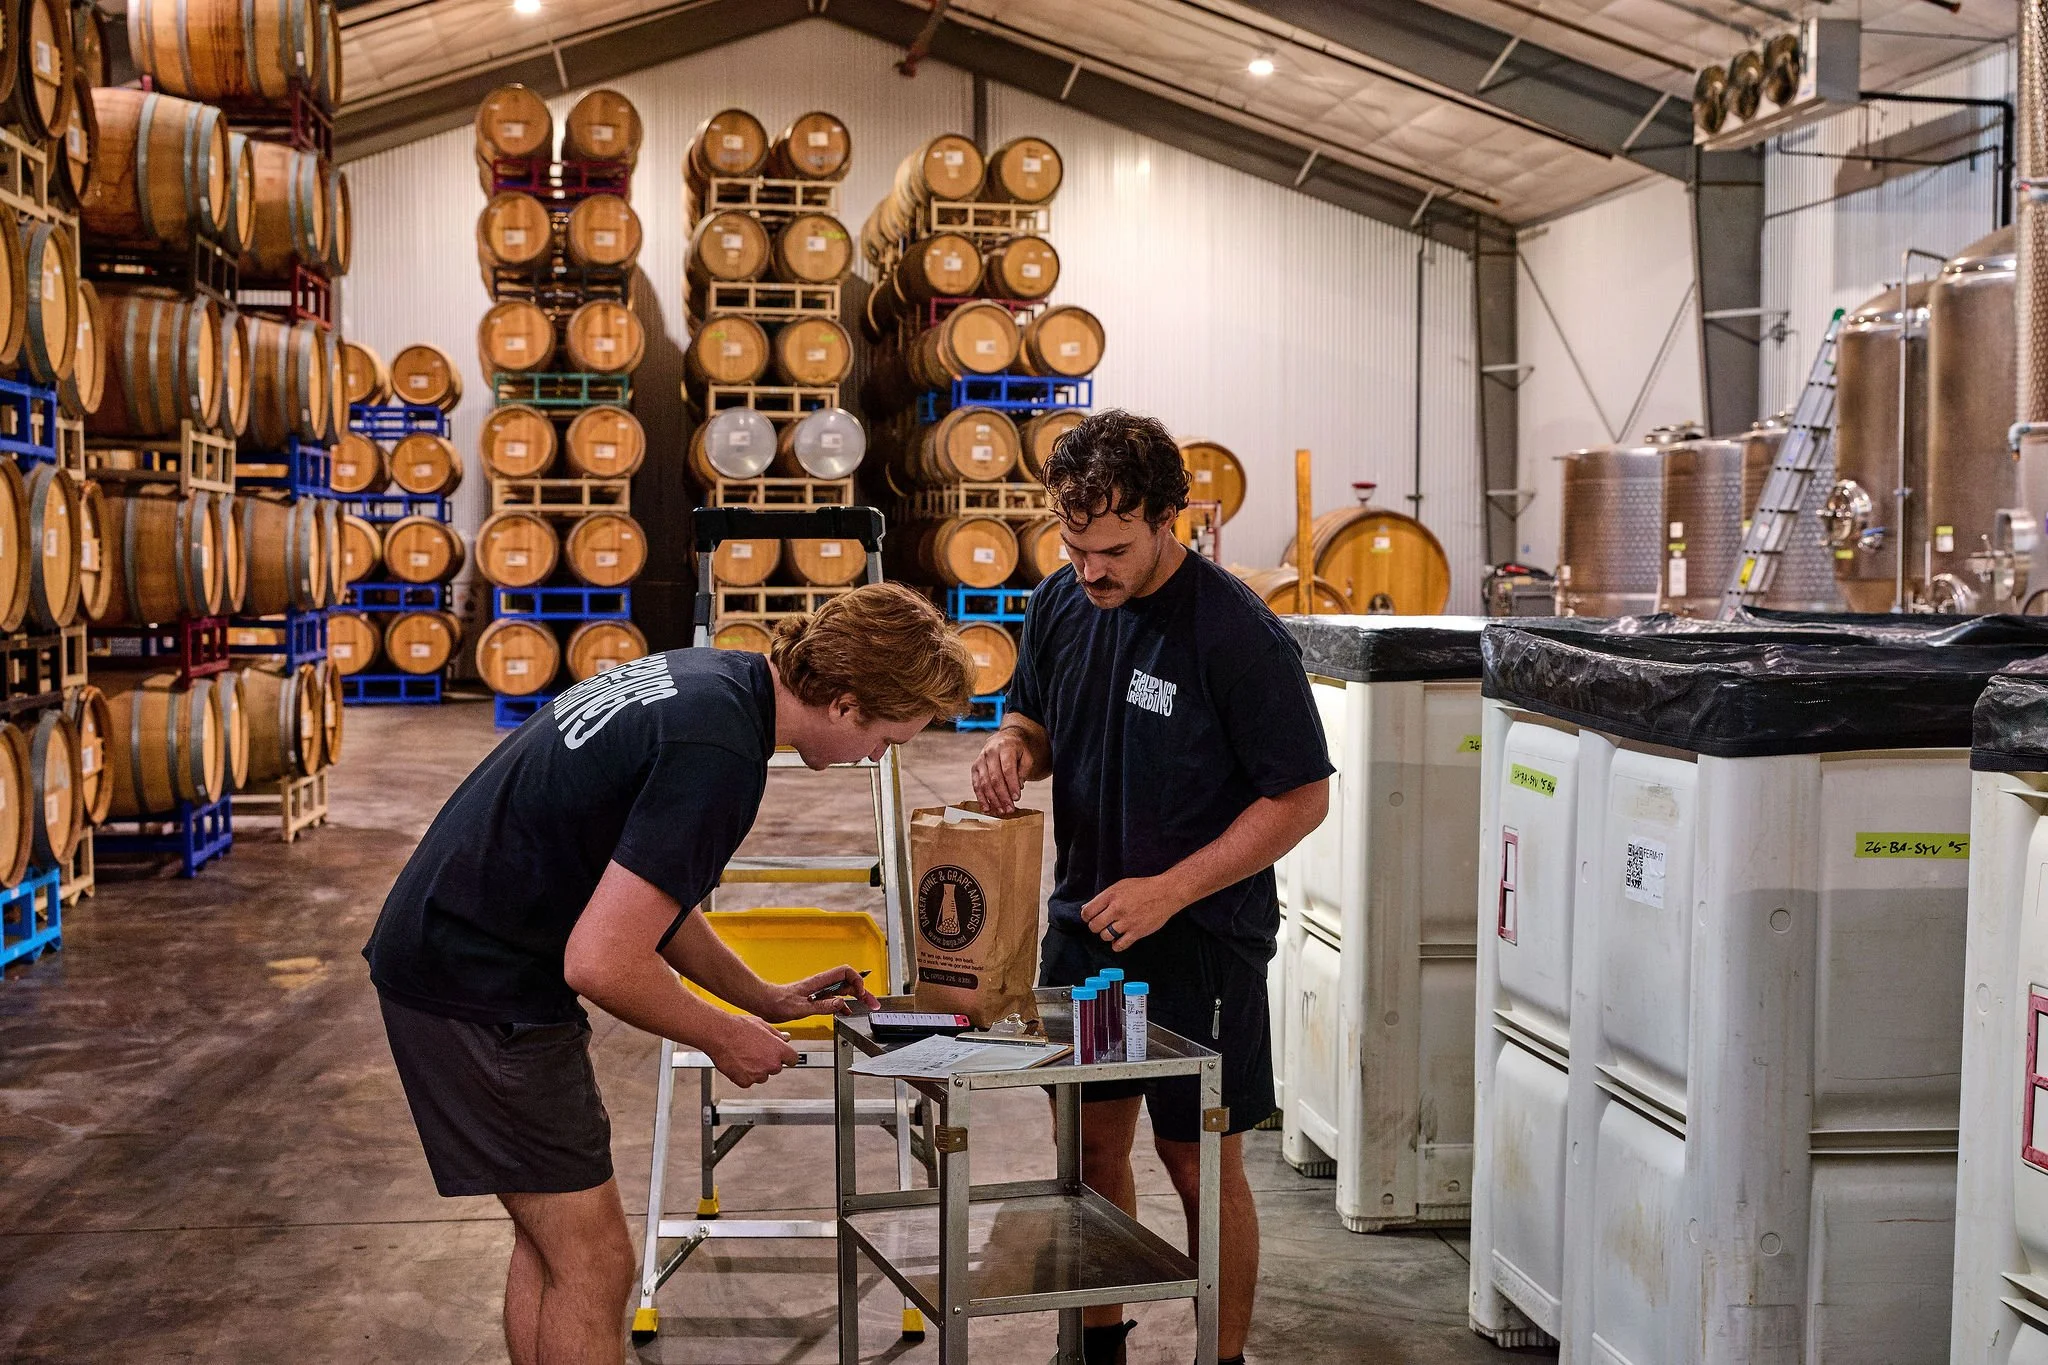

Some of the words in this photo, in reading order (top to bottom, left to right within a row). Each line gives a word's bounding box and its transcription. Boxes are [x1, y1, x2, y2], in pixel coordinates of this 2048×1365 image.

[1643, 848, 1664, 861] FERM-17
[1864, 841, 1942, 855] 26-BA-SYV
[1948, 840, 1968, 853] #5
[921, 873, 938, 895] WINE
[938, 870, 946, 881] &
[947, 869, 973, 890] GRAPE
[919, 896, 930, 928] BAKER
[966, 889, 982, 933] ANALYSIS
